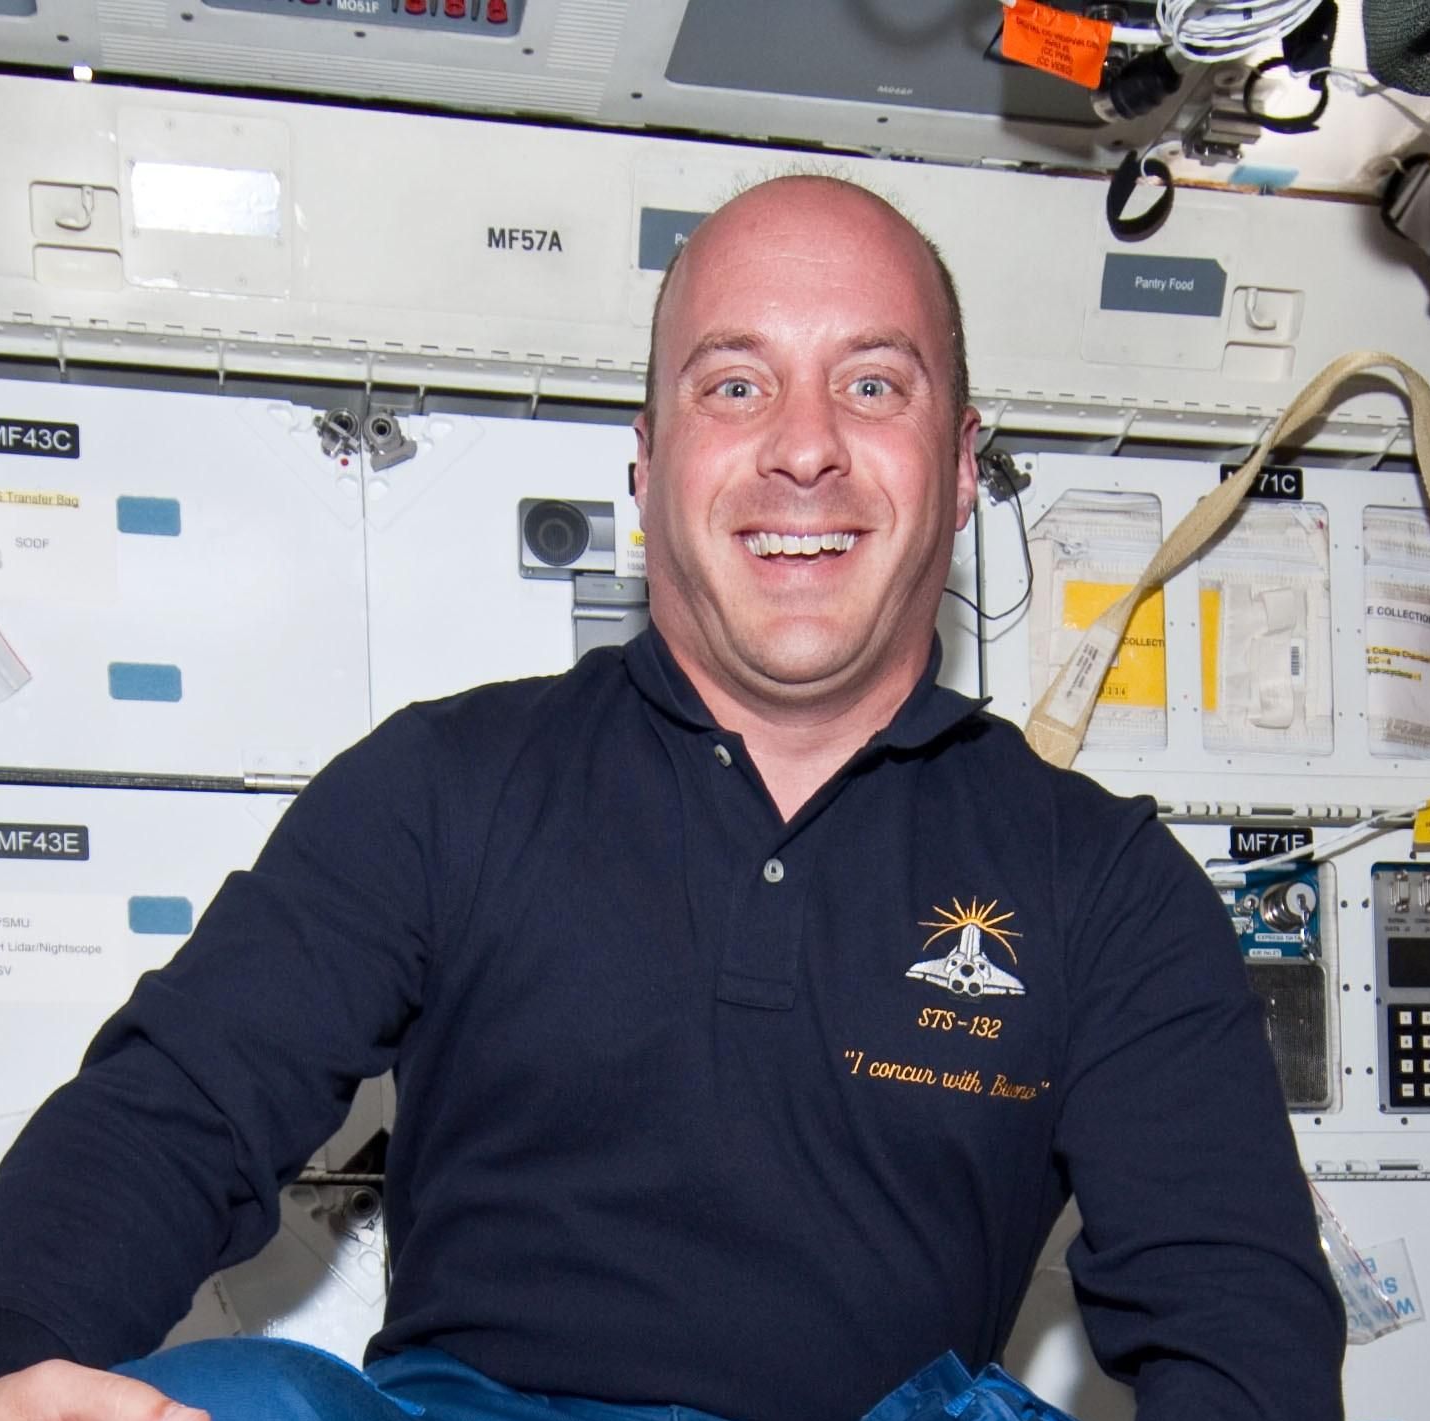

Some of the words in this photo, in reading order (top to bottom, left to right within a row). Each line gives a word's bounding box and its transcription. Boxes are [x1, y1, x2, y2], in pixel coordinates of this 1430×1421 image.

[486, 226, 564, 252] MF57A
[1134, 275, 1167, 293] Pantry
[1169, 277, 1195, 292] Food
[6, 490, 51, 506] Transfer
[54, 495, 80, 509] Bag
[7, 941, 103, 956] Lidar/Nightscope
[917, 1006, 1003, 1040] STS-132
[869, 1060, 937, 1085] concur
[942, 1069, 984, 1094] with
